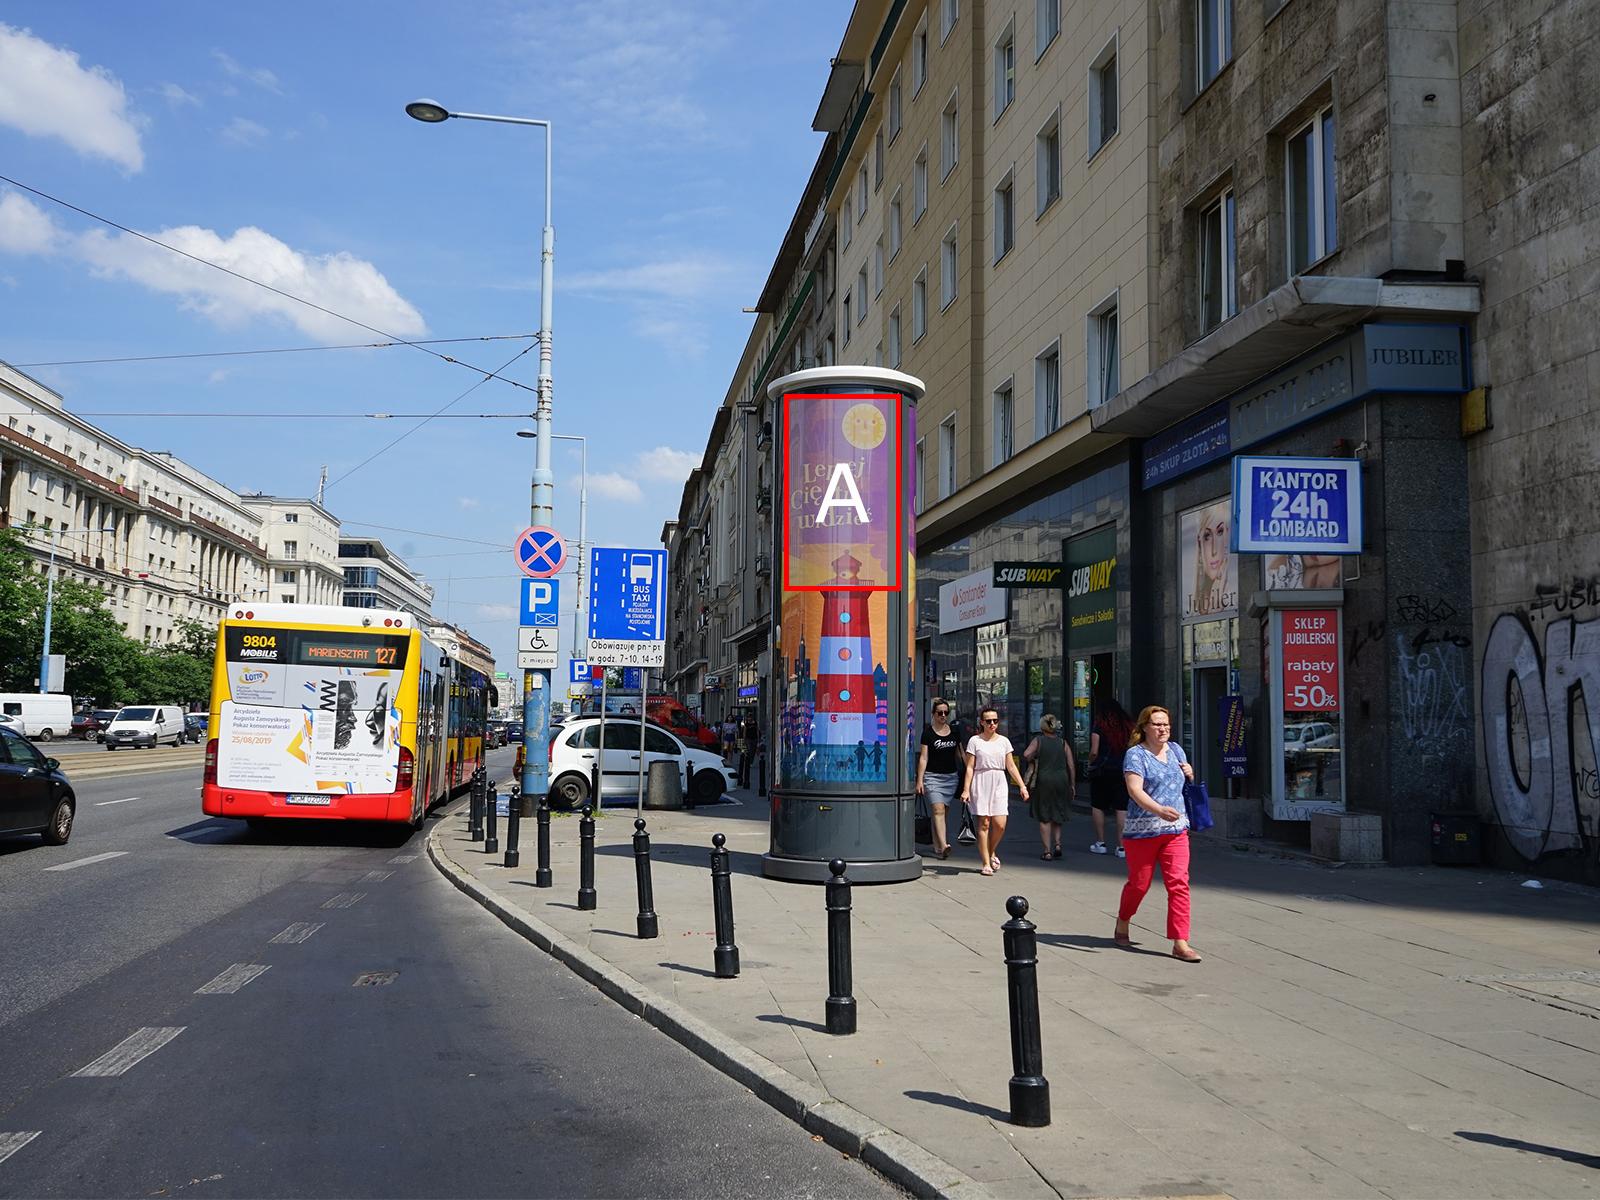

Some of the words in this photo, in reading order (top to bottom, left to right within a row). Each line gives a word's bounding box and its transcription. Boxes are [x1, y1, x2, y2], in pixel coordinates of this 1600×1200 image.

[1369, 348, 1459, 366] JUBILER
[1260, 471, 1338, 490] KANTOR
[791, 485, 823, 510] Cię
[1271, 490, 1329, 519] 24h
[1259, 519, 1339, 538] LOMBARD
[996, 568, 1061, 583] SUBWAY
[1068, 556, 1117, 598] SUBWAY
[633, 585, 650, 593] BUS
[960, 584, 987, 605] Santander
[529, 582, 552, 612] P
[632, 594, 650, 602] TAXI
[1187, 589, 1237, 616] Jubiler
[1294, 617, 1326, 630] SKLEP
[243, 635, 277, 648] 9804
[1285, 632, 1335, 645] JUBILERSKI
[591, 640, 635, 652] Obowiązuje
[240, 649, 278, 658] MOBILIS
[309, 647, 369, 660] MARIENSZTAT
[375, 648, 397, 664] 127
[642, 655, 663, 664] 14-19
[1287, 660, 1335, 673] rabaty
[244, 672, 264, 682] LOTTO
[1302, 672, 1320, 683] do
[1287, 685, 1337, 708] -50%
[232, 736, 272, 744] 25/08/2019
[1231, 766, 1245, 775] 24h
